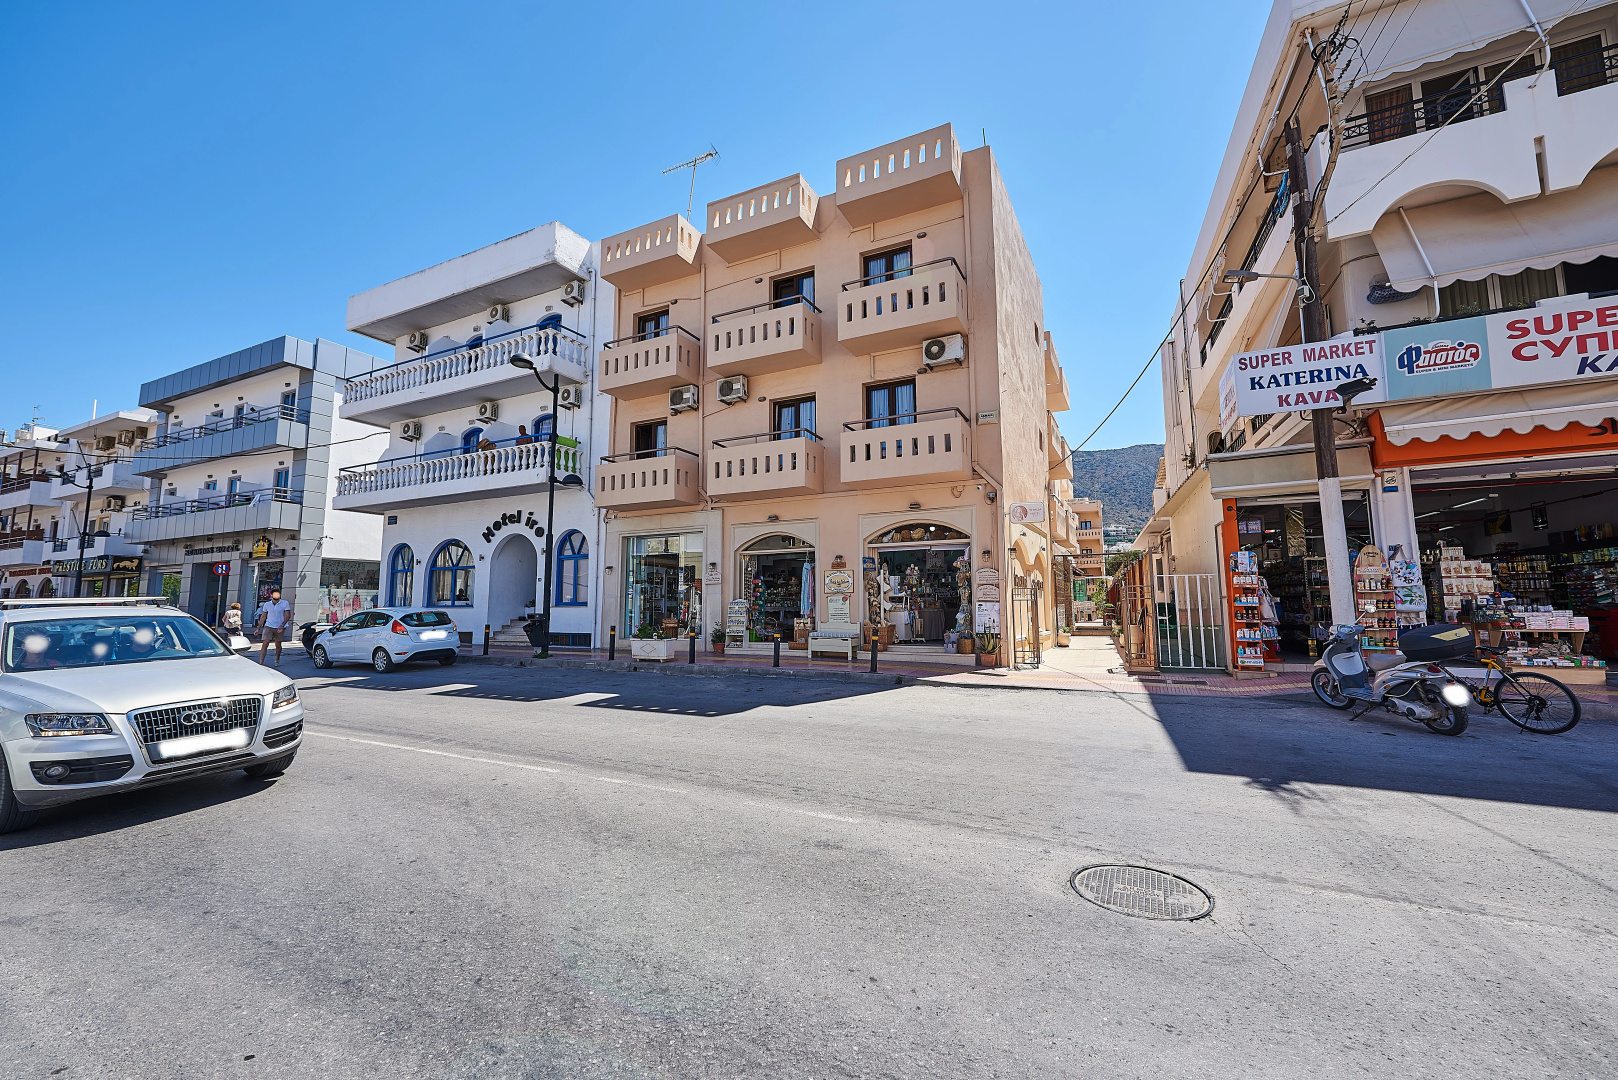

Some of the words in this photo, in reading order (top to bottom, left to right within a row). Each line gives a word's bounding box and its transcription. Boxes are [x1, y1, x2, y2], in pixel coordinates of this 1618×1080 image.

[1238, 351, 1293, 371] SUPER
[1303, 340, 1376, 362] MARKET
[1249, 363, 1370, 390] KATERINA
[1277, 389, 1340, 407] KAVA
[482, 510, 522, 543] Hotel
[525, 511, 545, 538] iro
